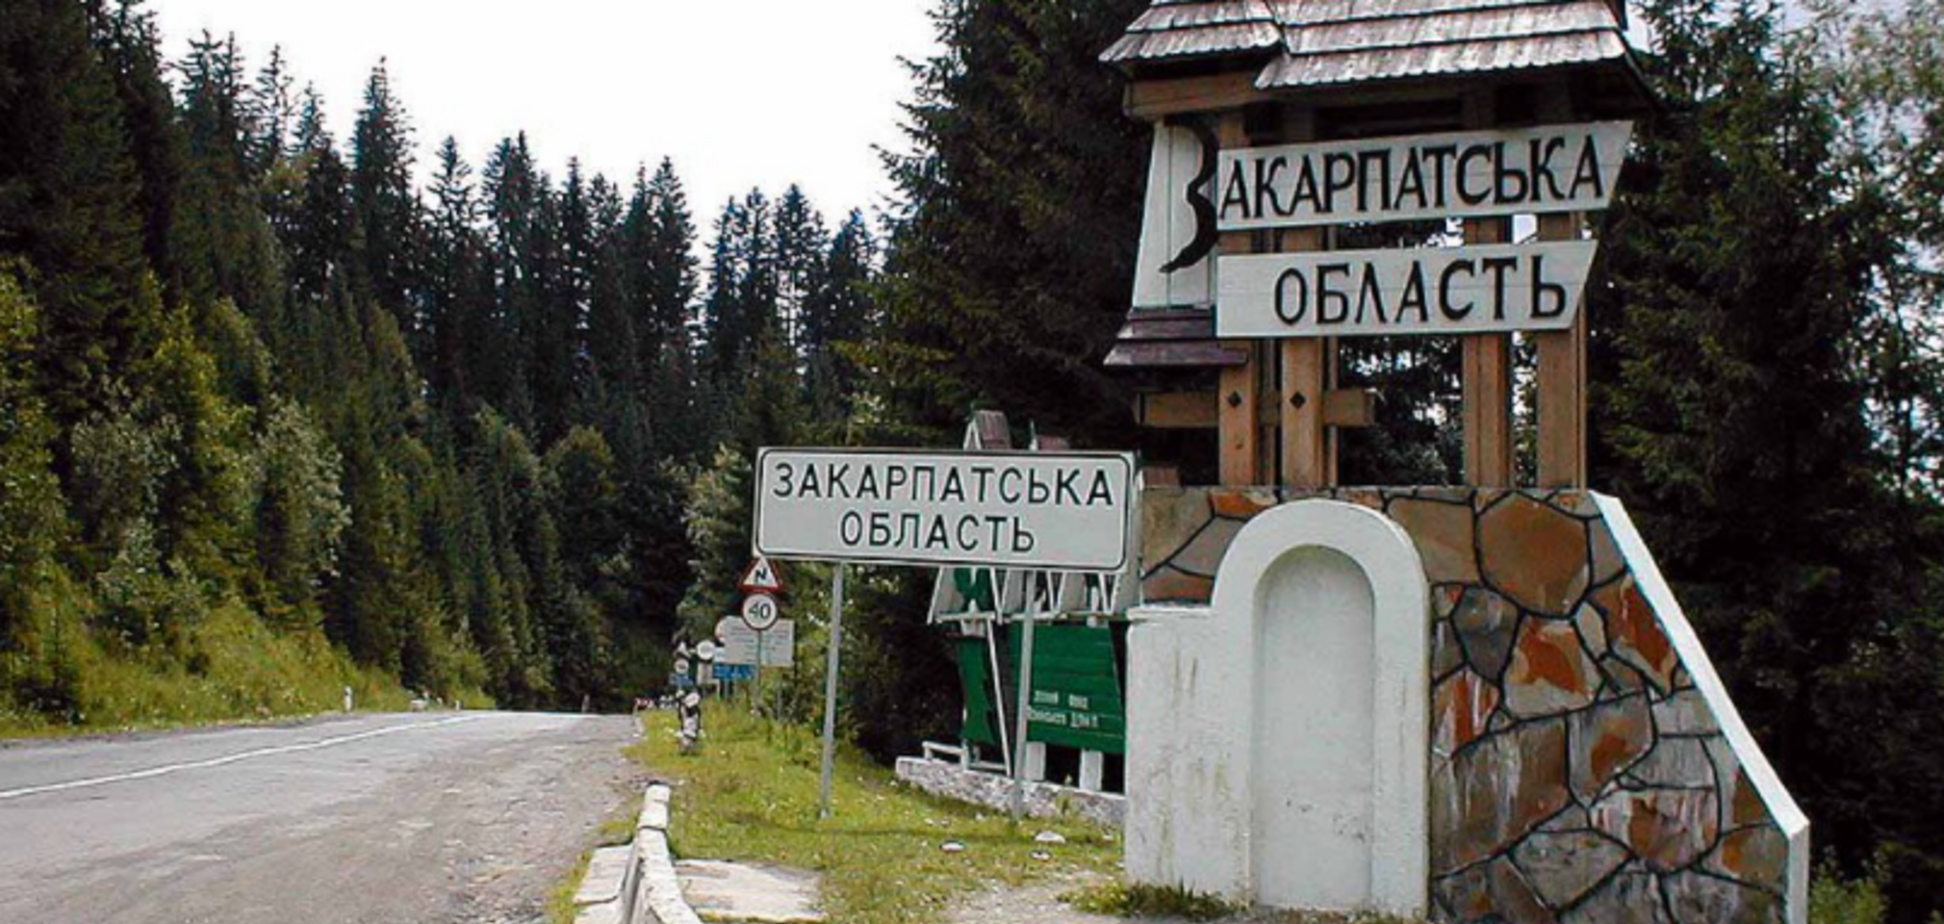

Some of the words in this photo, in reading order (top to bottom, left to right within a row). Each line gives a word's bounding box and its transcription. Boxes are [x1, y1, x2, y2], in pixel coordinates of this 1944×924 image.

[1159, 115, 1606, 274] ЗАКАРПАТСЬКА
[1273, 255, 1567, 327] ОБЛАСТЬ
[773, 462, 1114, 506] ЗАКАРПАТСЬКА
[839, 510, 1036, 553] ОБЛАСТЬ
[748, 602, 772, 620] 40
